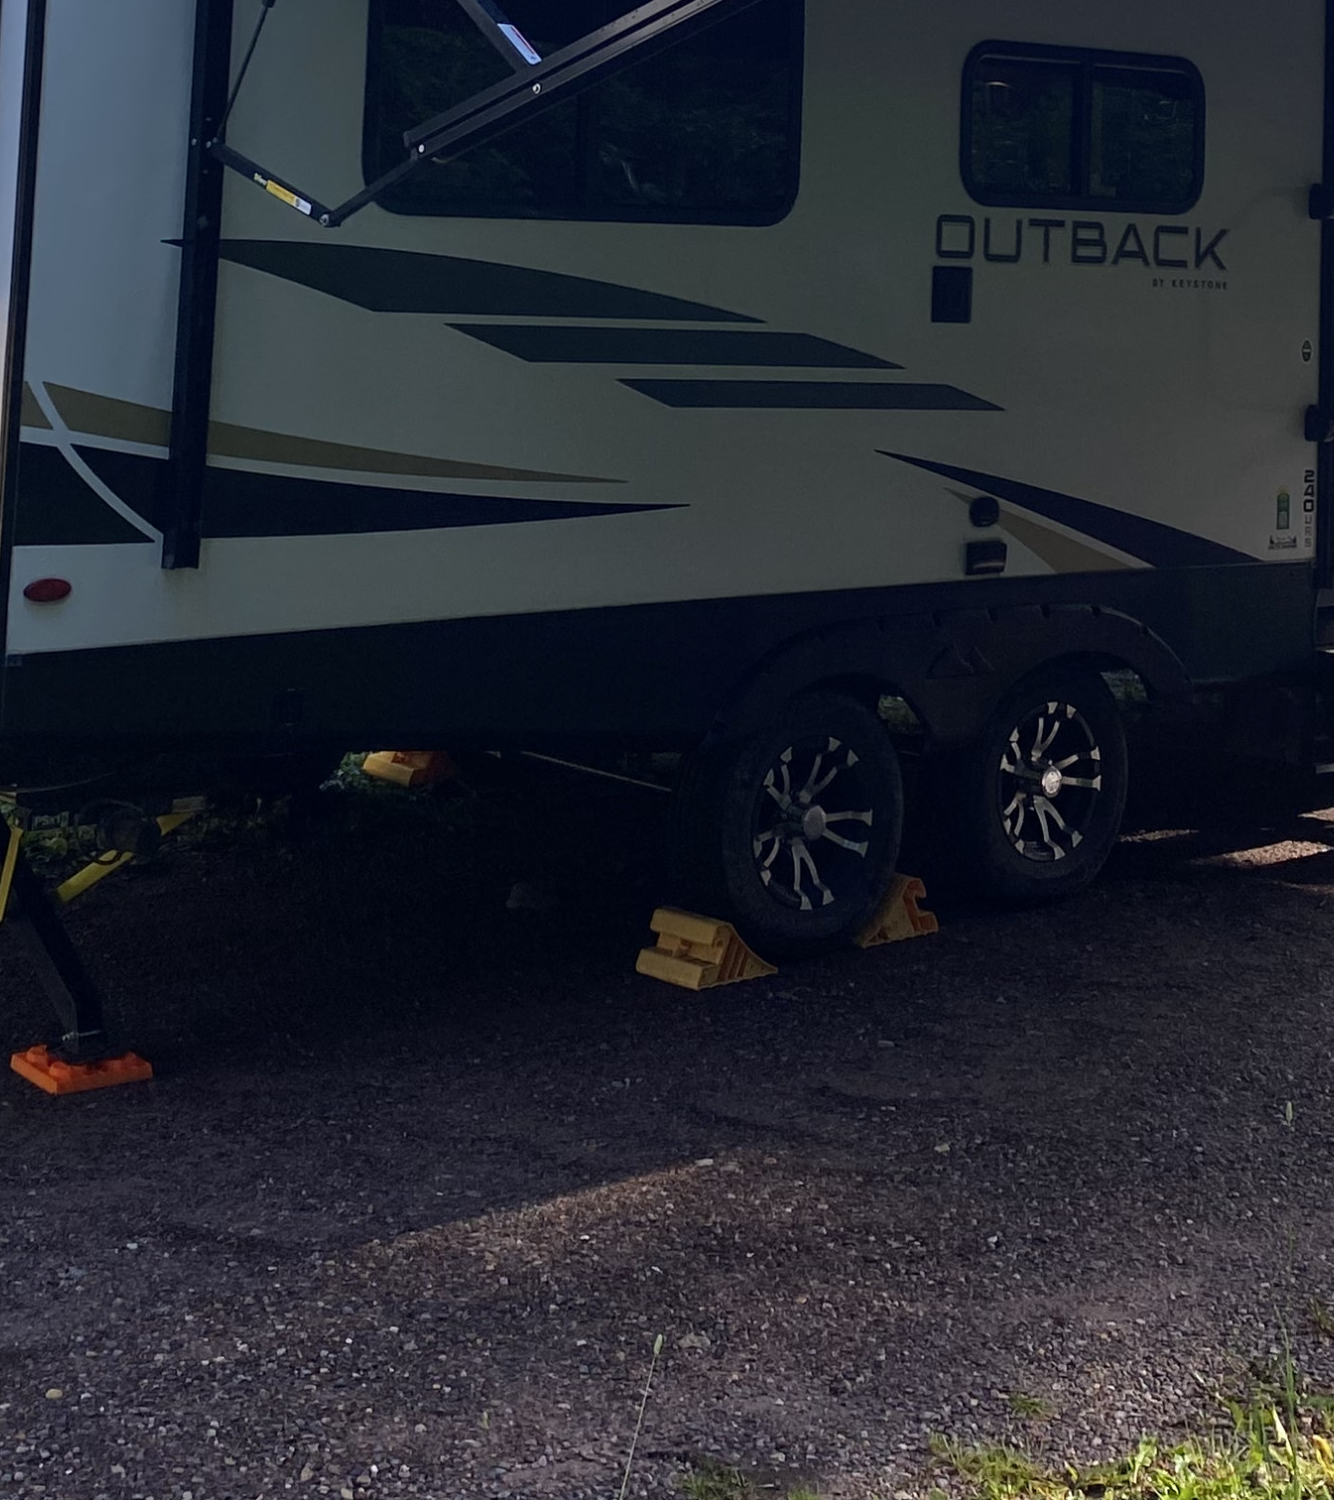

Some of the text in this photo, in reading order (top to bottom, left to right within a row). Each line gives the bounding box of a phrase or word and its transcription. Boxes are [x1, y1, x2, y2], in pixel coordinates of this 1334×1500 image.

[935, 213, 1232, 273] OUTBACK
[1152, 277, 1228, 291] BY KEYSTONE
